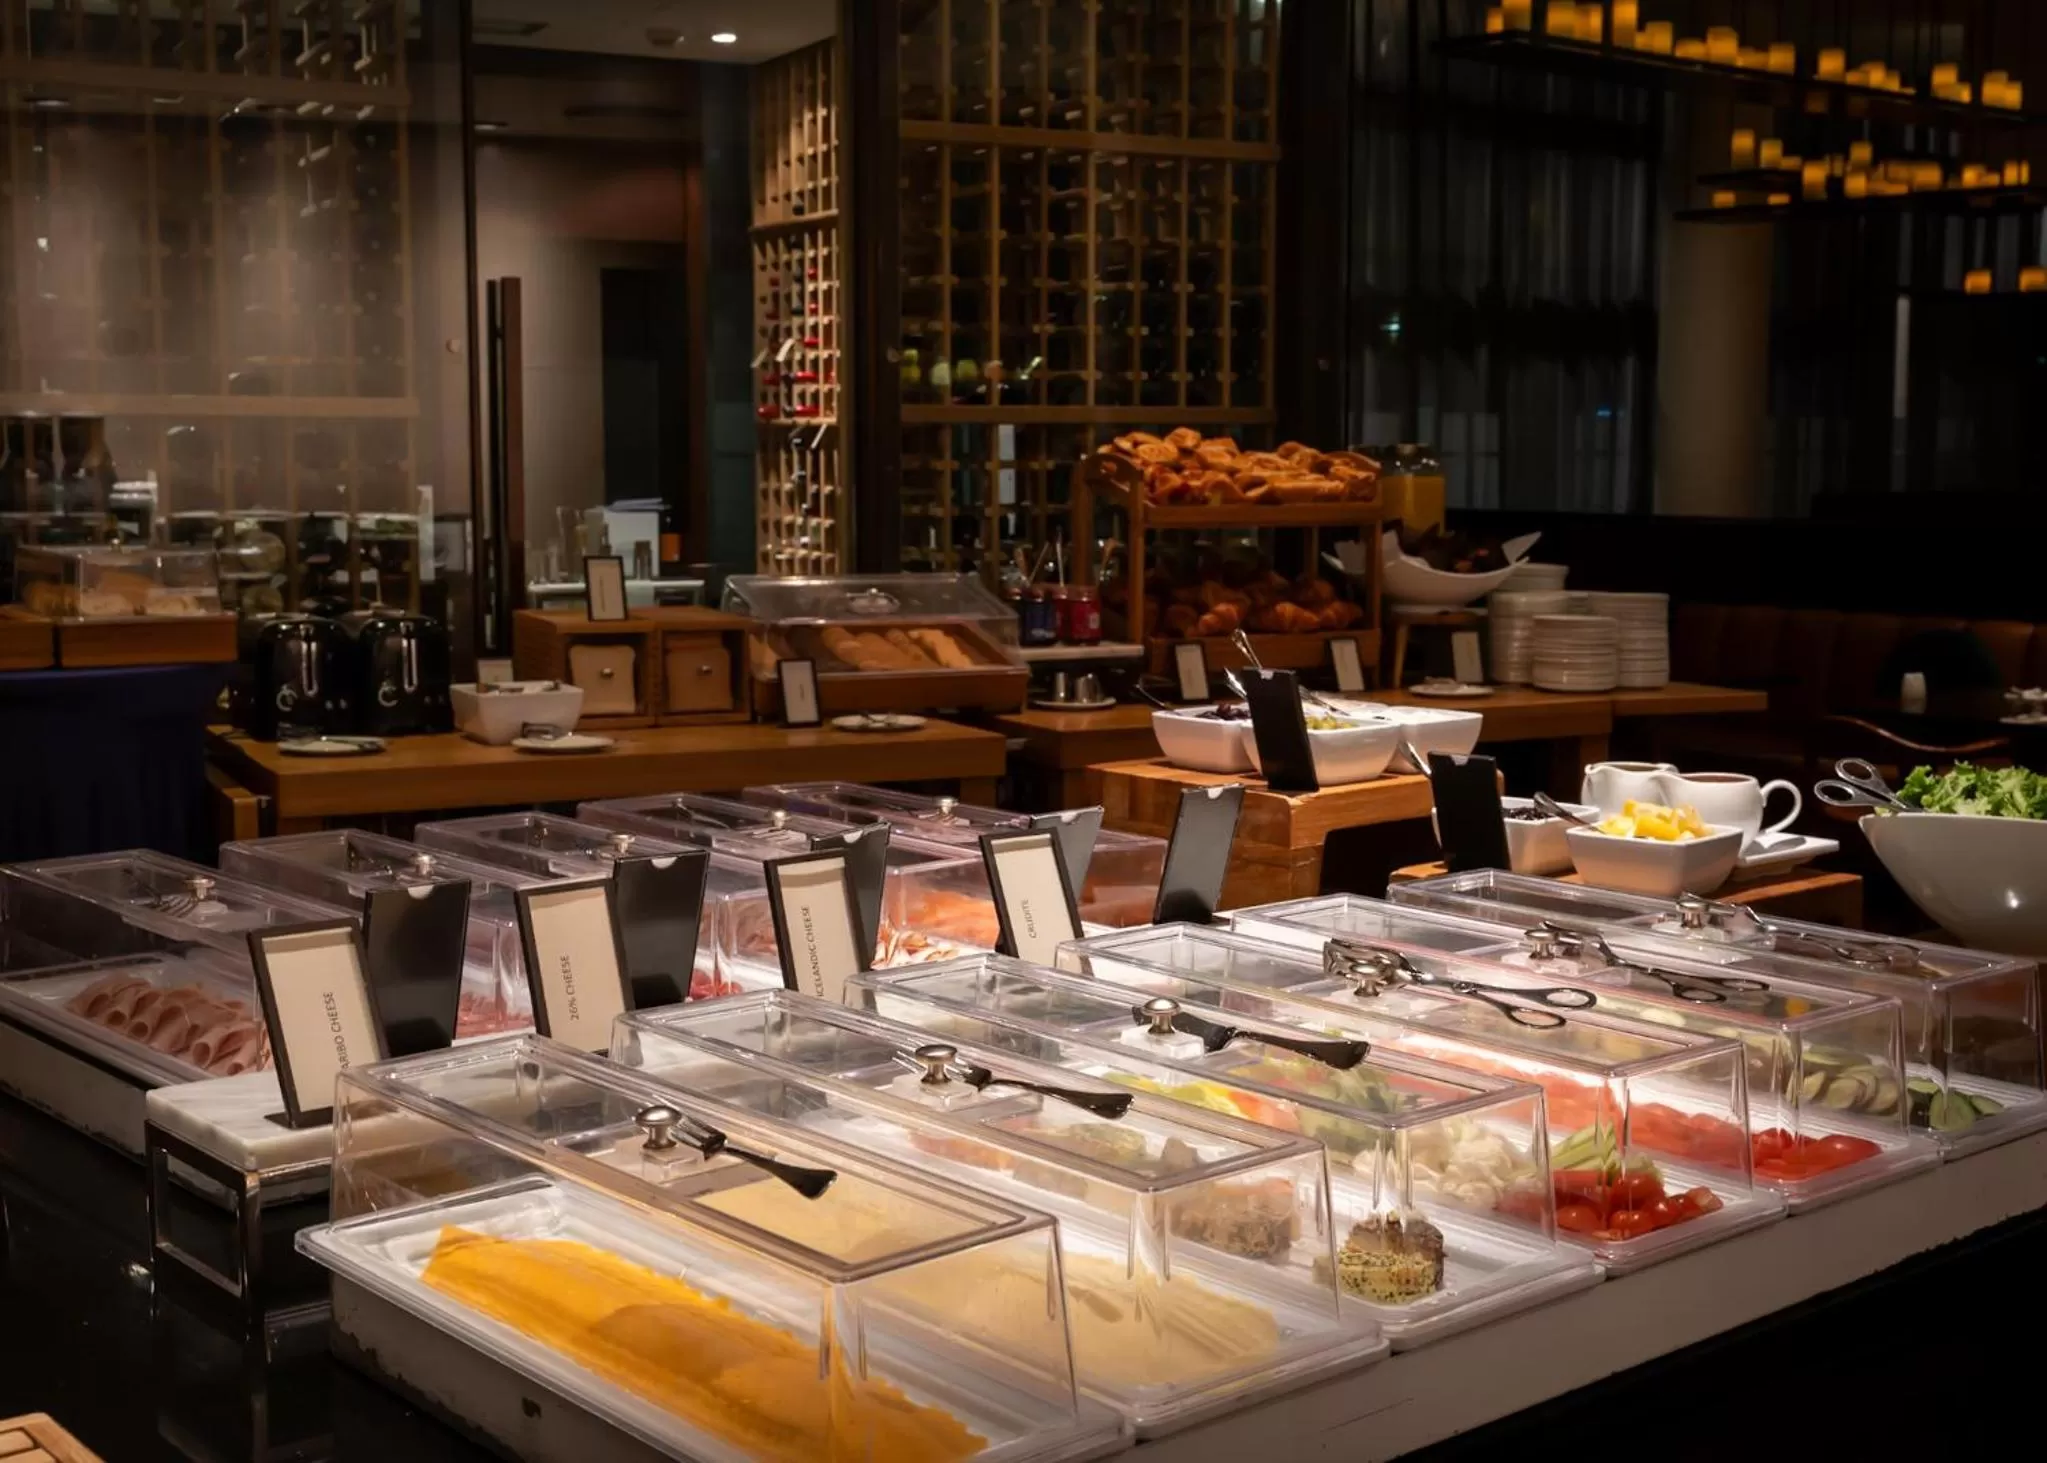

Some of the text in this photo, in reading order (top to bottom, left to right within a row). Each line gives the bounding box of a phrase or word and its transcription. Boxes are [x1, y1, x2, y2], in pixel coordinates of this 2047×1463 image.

[560, 955, 576, 996] CHEESE
[801, 906, 825, 997] ICELANDIC CHEESE
[322, 991, 351, 1070] ARIBO CHEESE
